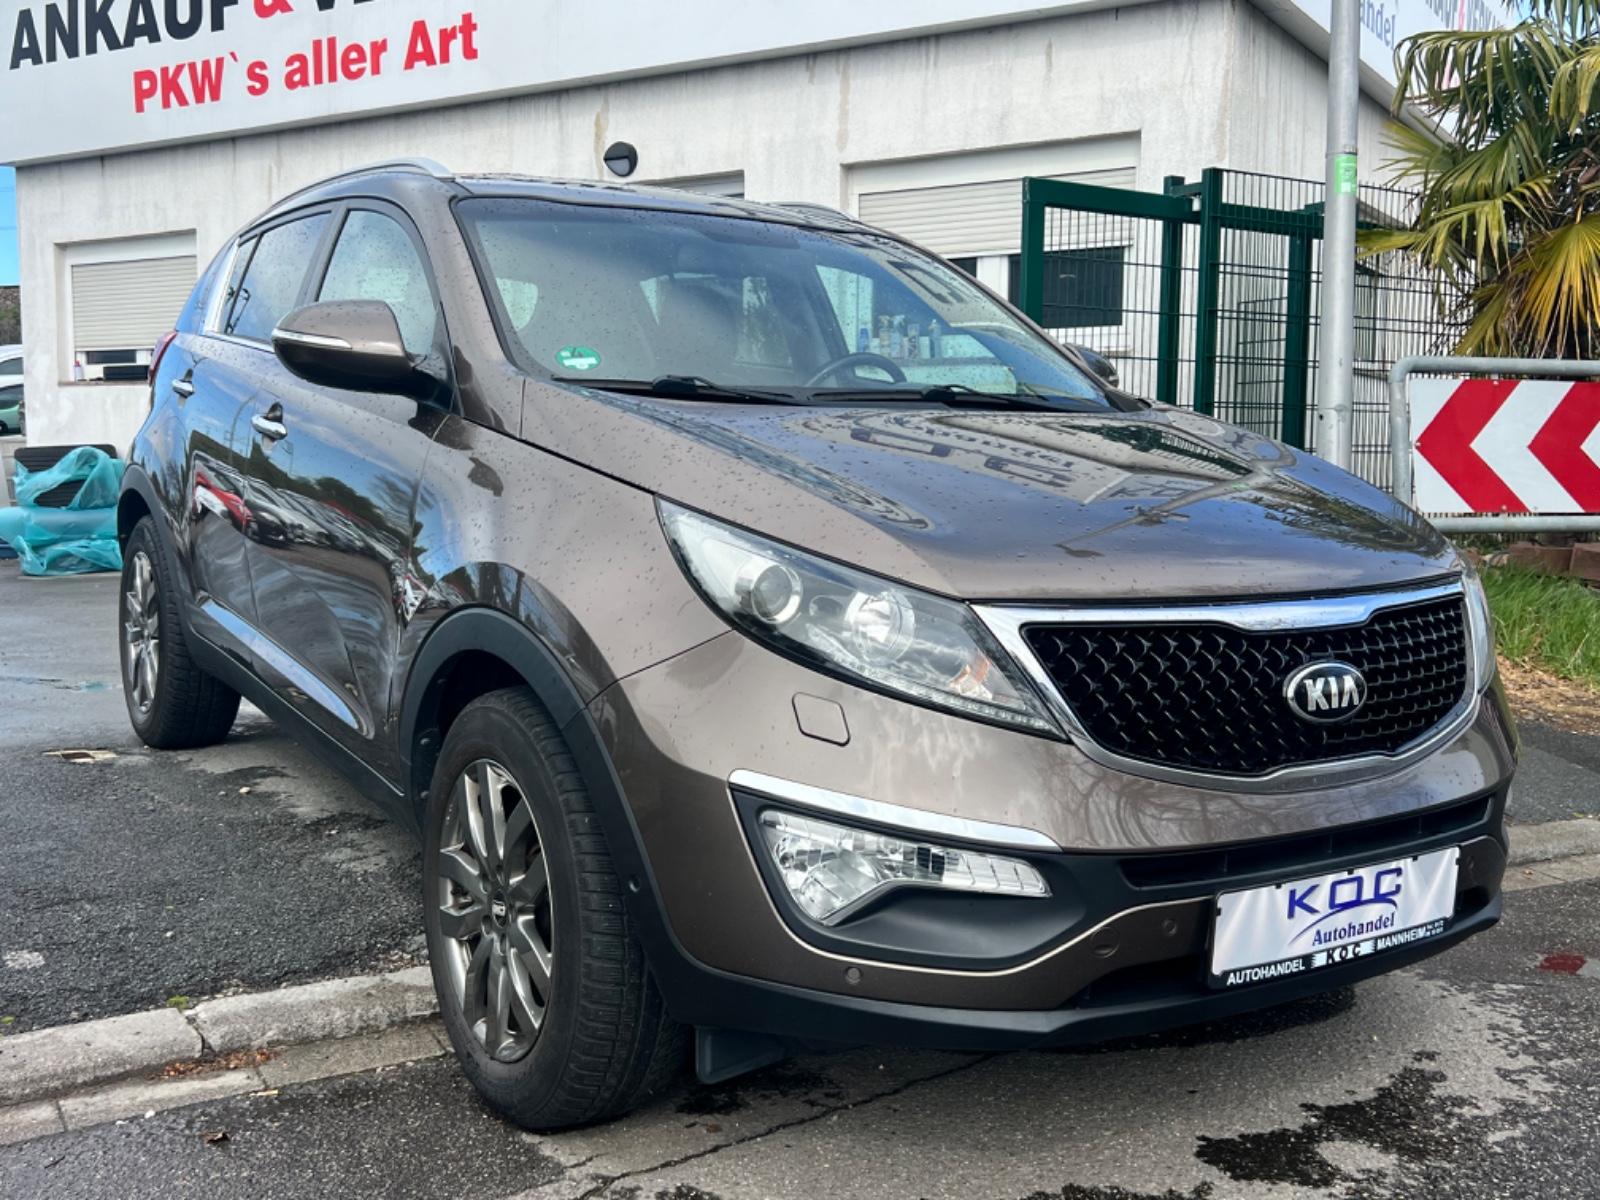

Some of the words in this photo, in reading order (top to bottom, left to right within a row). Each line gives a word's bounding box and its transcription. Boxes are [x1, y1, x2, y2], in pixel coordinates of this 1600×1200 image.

[284, 36, 388, 91] aller
[403, 12, 478, 70] Art
[1303, 674, 1360, 711] KIA
[1287, 867, 1403, 920] KOC
[1312, 911, 1396, 946] Autohandel
[1226, 958, 1306, 986] AUTOHANDEL
[1376, 926, 1427, 951] MANNHEIM
